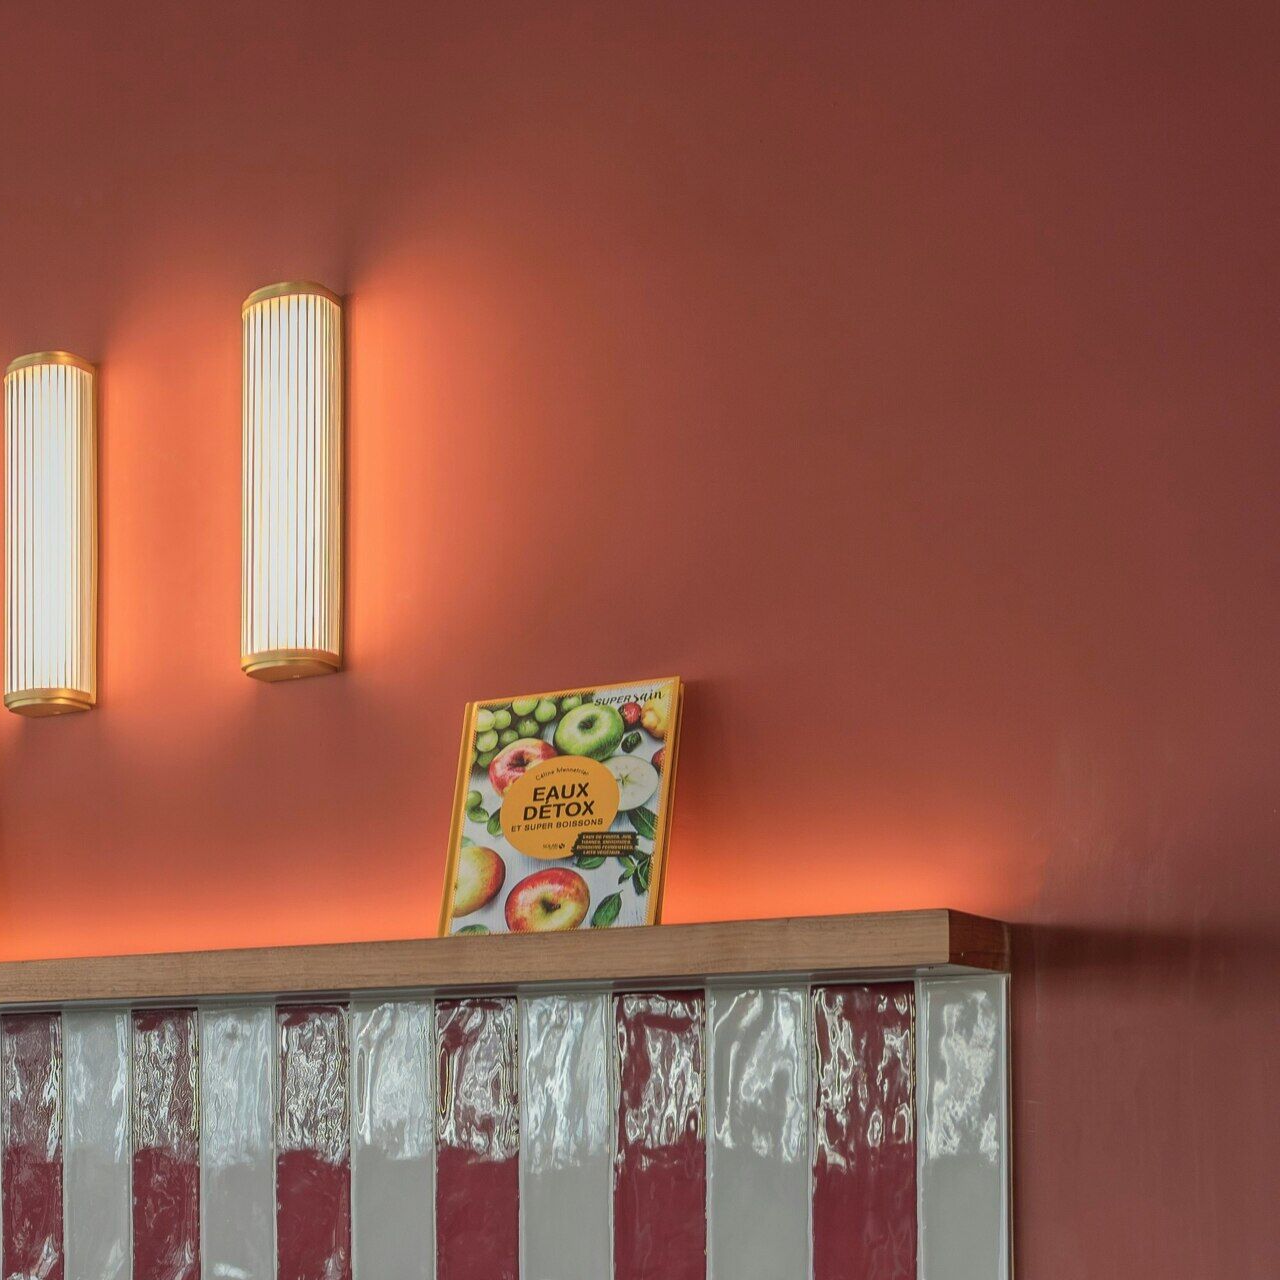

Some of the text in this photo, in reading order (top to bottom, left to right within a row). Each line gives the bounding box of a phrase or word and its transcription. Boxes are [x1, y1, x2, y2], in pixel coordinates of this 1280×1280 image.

[594, 694, 631, 706] SUPER
[532, 781, 589, 802] EAUX
[523, 798, 595, 821] DÉTOX
[511, 817, 604, 833] ET SUPER BOISSONS
